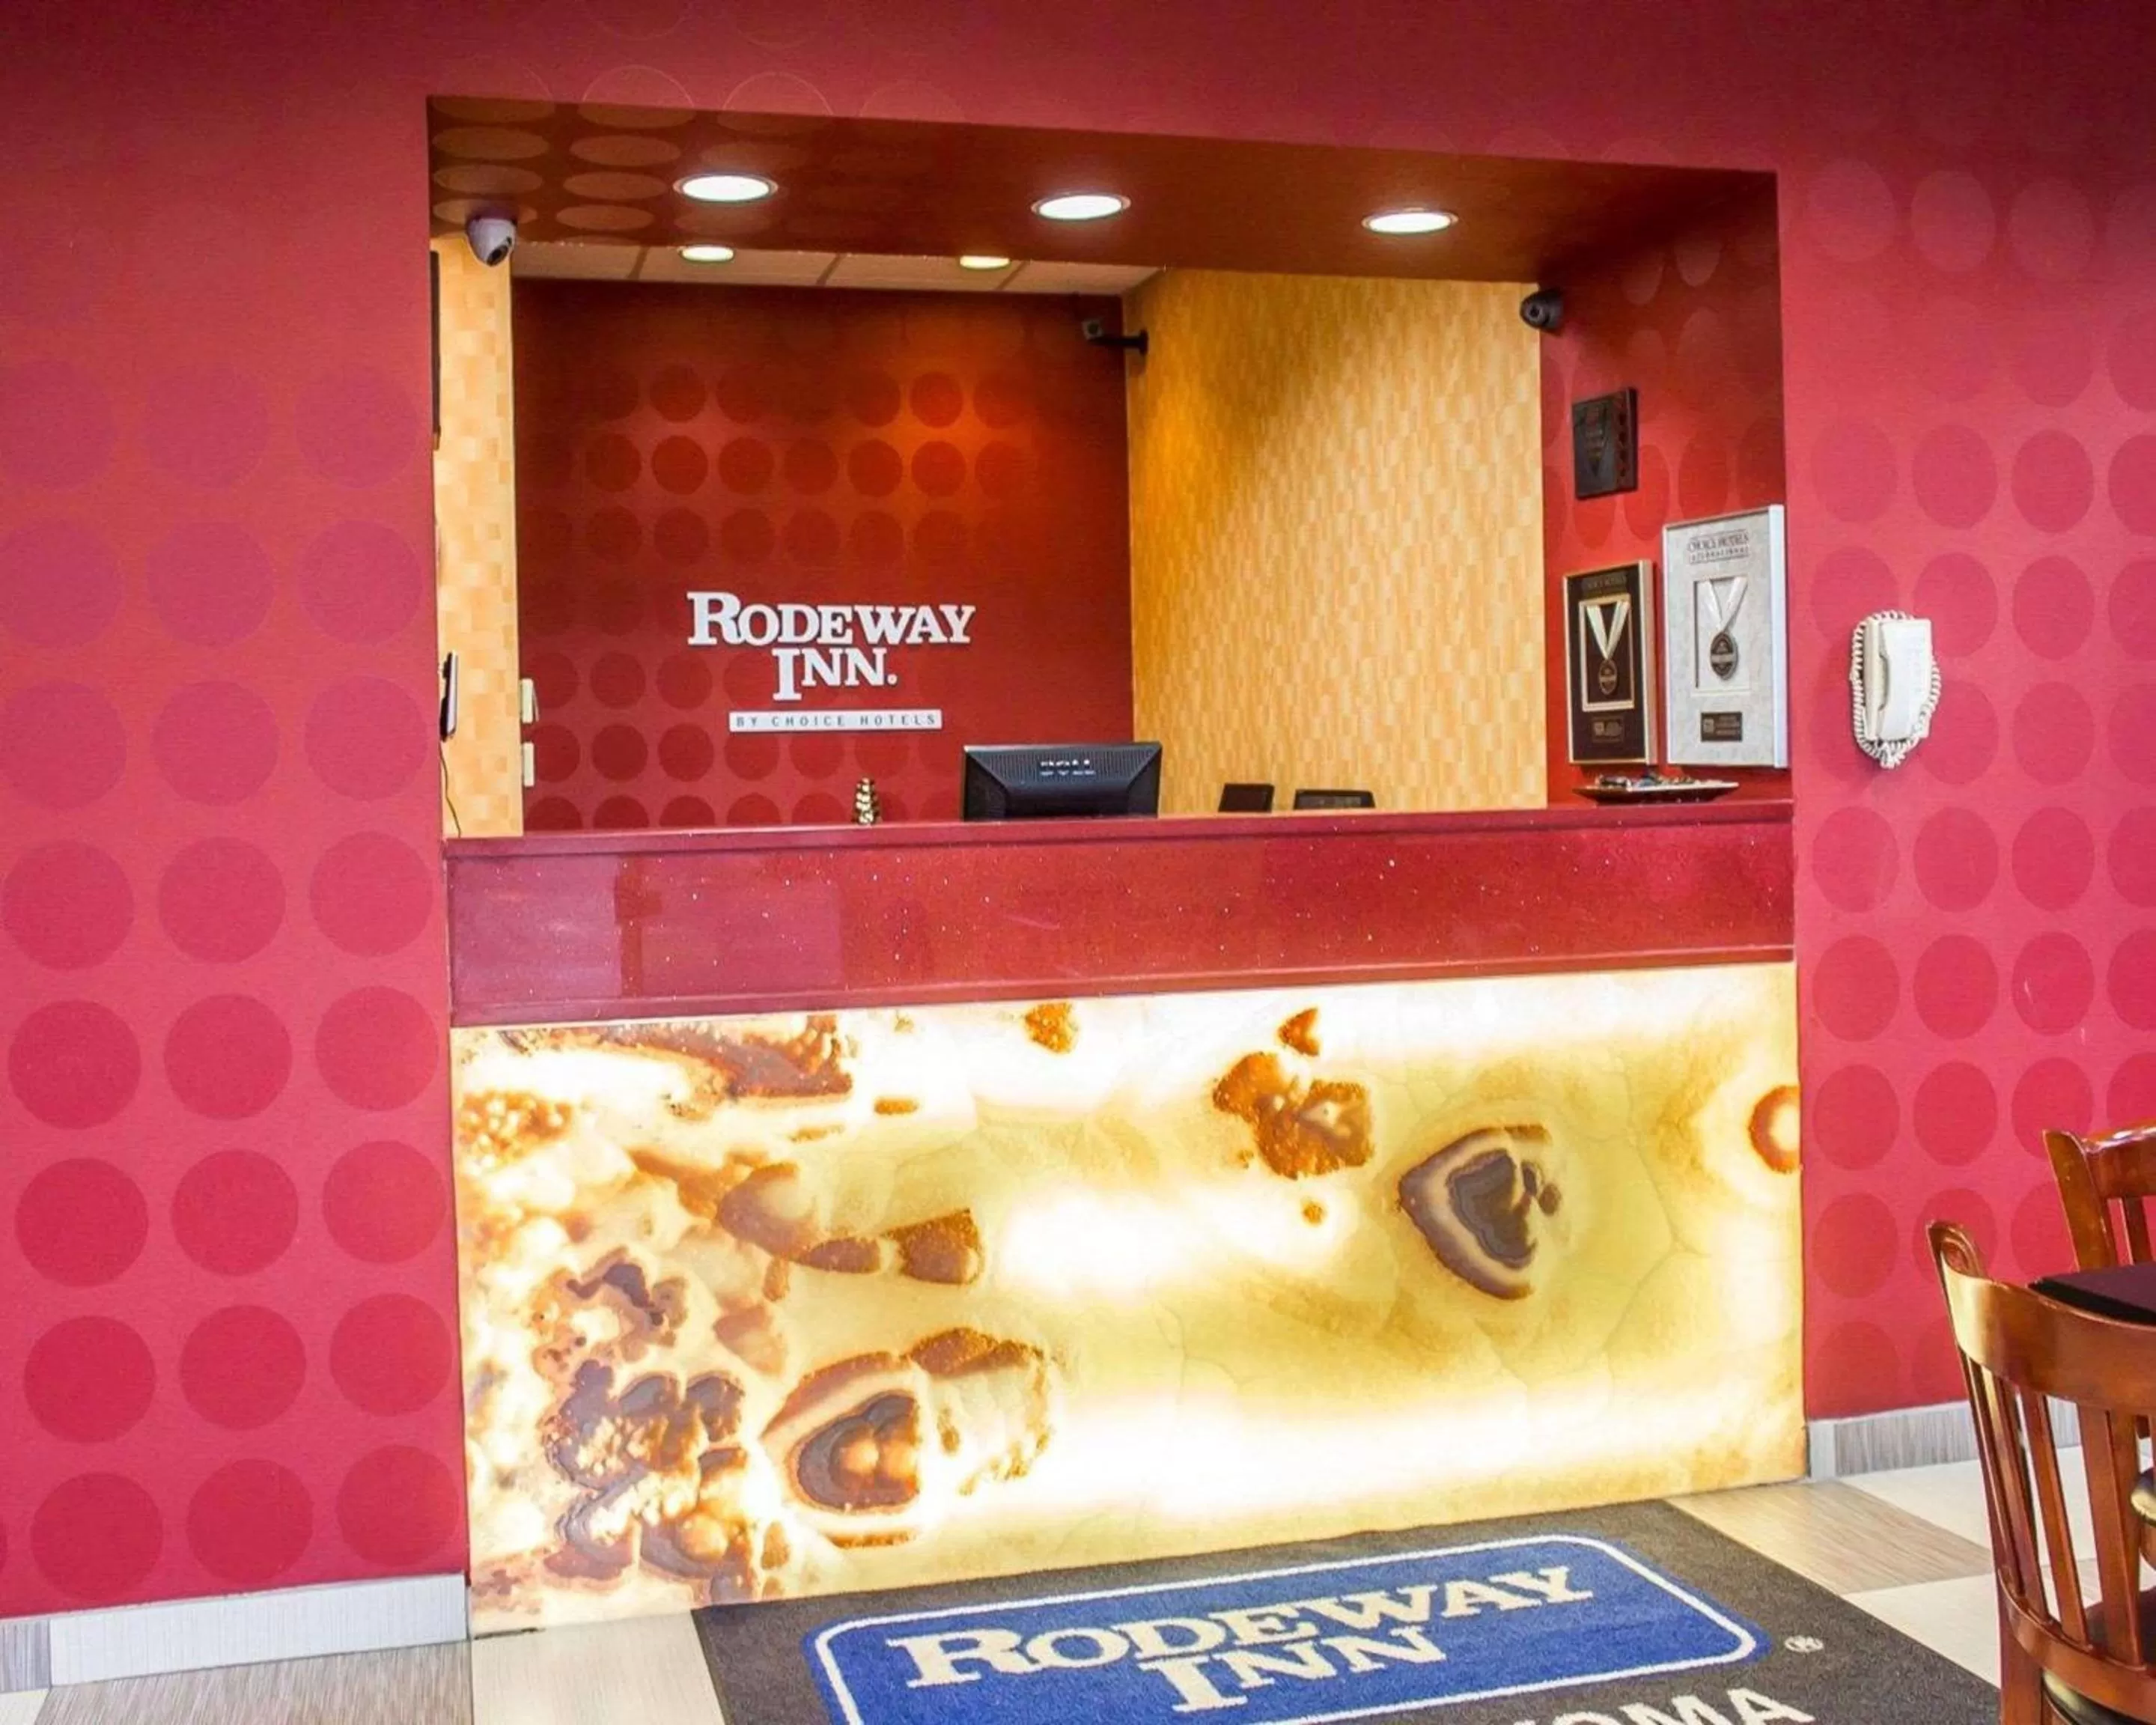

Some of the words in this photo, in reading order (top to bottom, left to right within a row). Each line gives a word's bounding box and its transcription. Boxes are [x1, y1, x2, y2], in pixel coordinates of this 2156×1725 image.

[686, 591, 976, 646] RODEWAY
[736, 717, 758, 728] BY
[771, 715, 845, 727] CHOICE
[860, 714, 936, 726] HOTELS
[886, 1566, 1593, 1688] RODEWAY
[1140, 1625, 1447, 1713] INN
